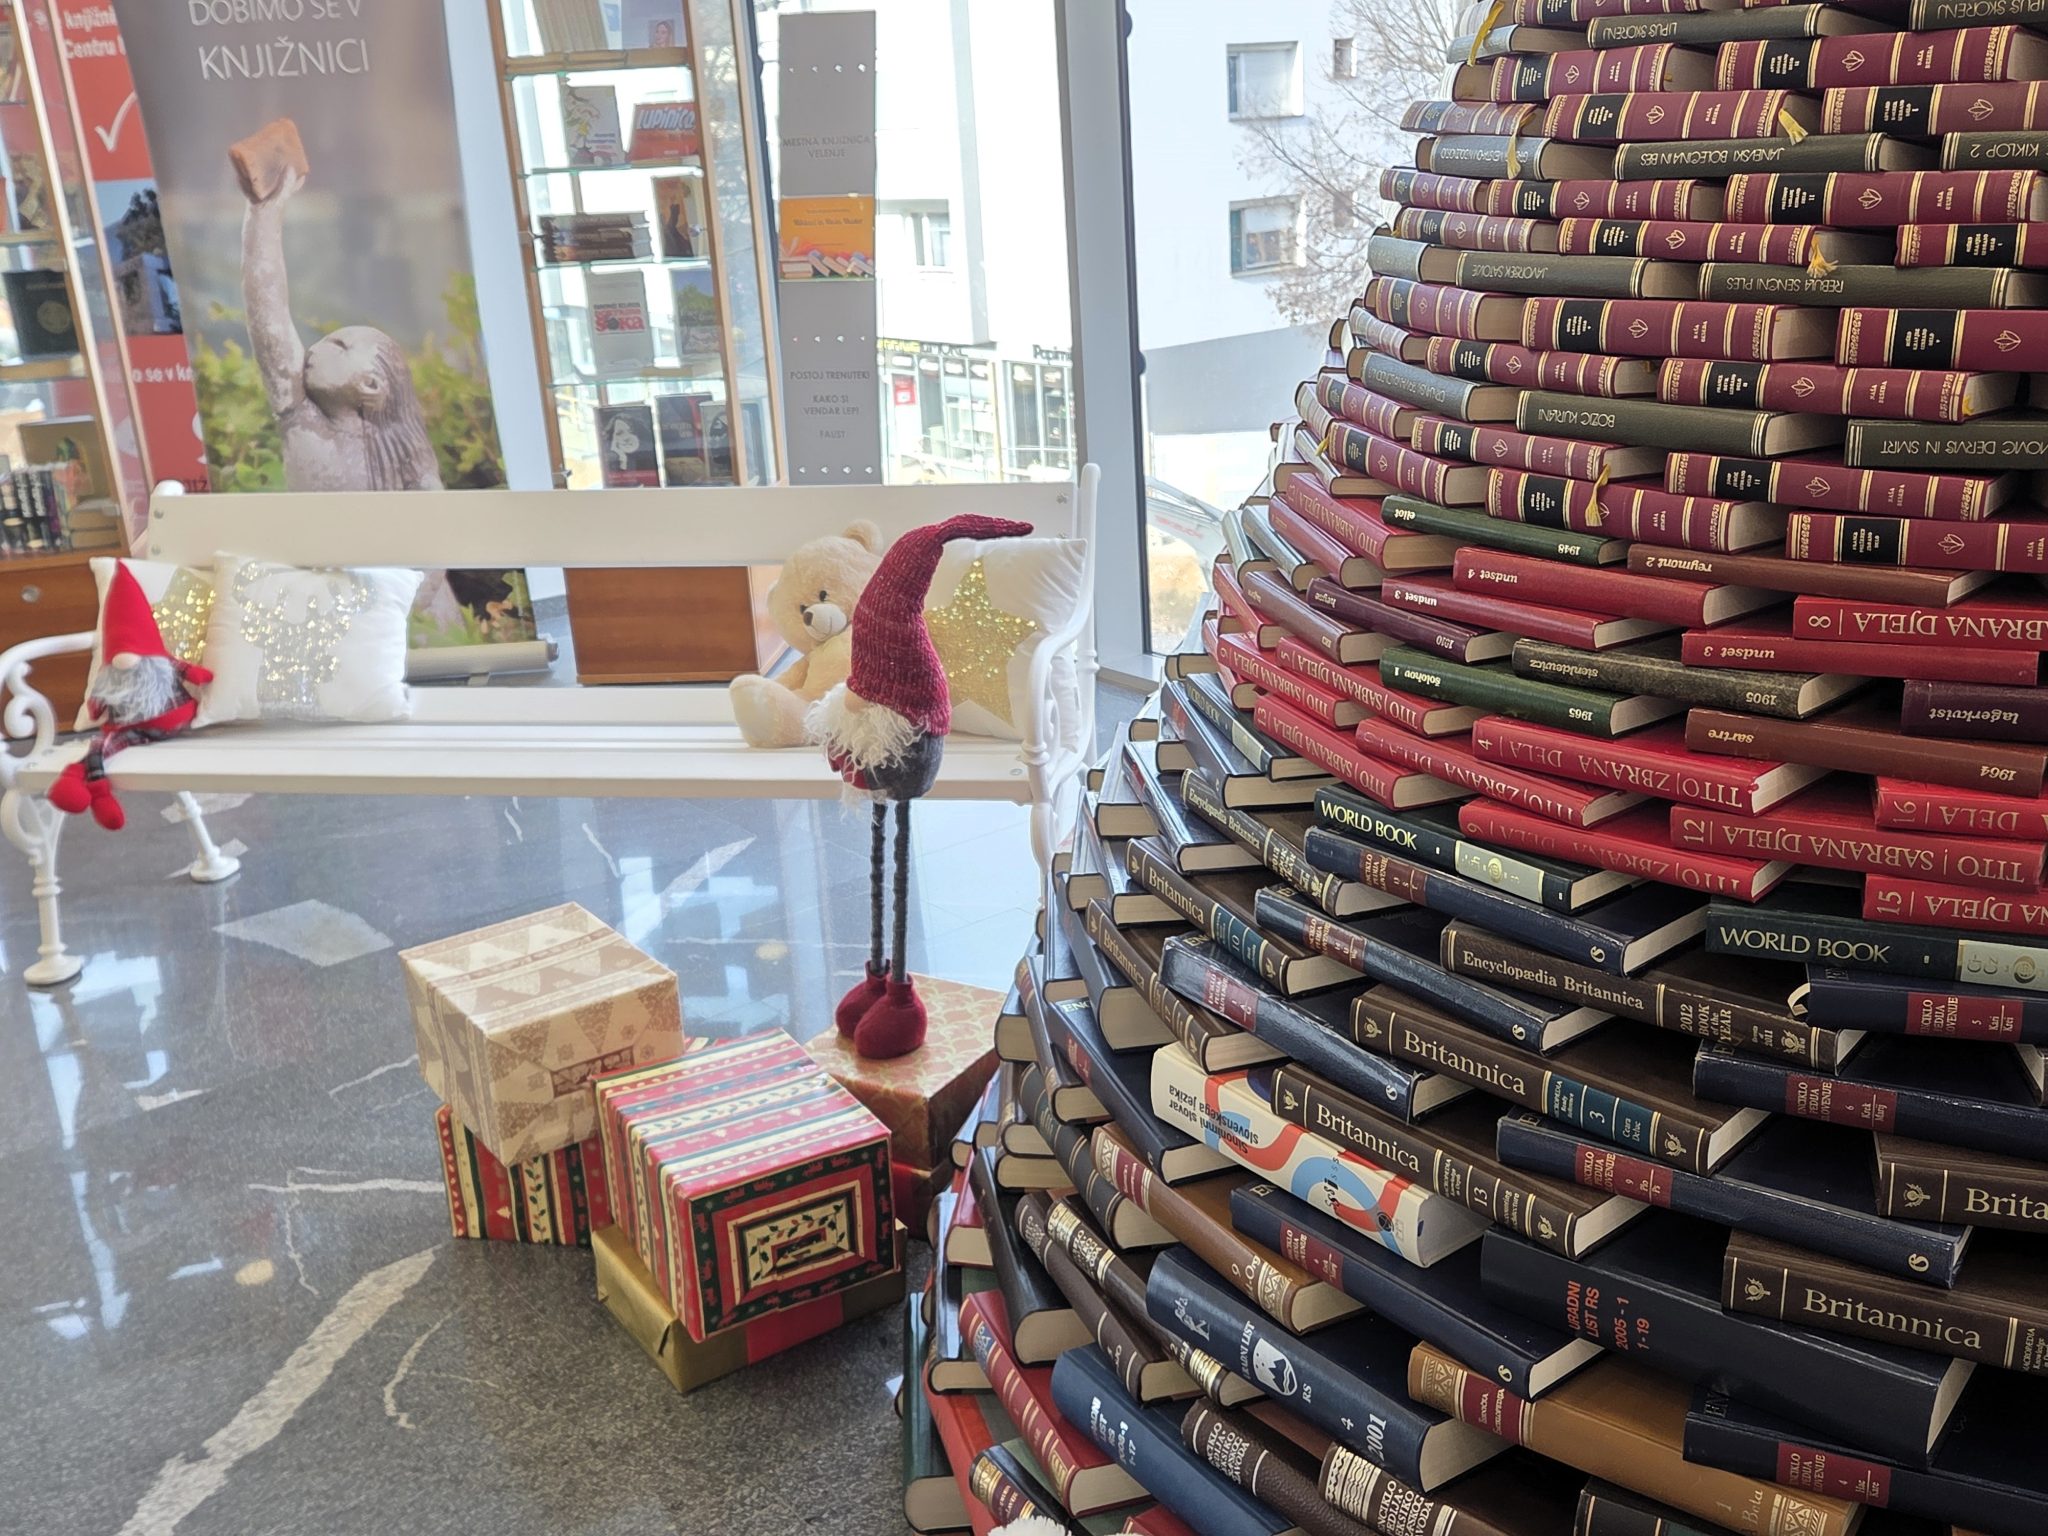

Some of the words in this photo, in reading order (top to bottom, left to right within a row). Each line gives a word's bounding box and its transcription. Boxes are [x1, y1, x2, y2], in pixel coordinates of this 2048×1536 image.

[189, 0, 302, 26] DOBIMO
[310, 0, 342, 21] SE
[347, 0, 363, 18] V
[199, 36, 370, 81] KNJIŽNICI
[808, 149, 847, 159] VELENJE
[1640, 153, 1659, 166] BES
[1969, 144, 1981, 158] 2
[1986, 143, 2040, 159] KIKLOP
[1726, 277, 1754, 290] PLES
[812, 394, 839, 404] KAKO
[1879, 440, 1920, 456] SMRT
[1925, 440, 1941, 455] IN
[1394, 508, 1416, 521] eliot
[1557, 543, 1581, 556] 1948
[1646, 556, 1654, 567] 2
[1479, 568, 1518, 584] undset
[1657, 556, 1713, 574] reymont
[1394, 589, 1401, 600] 3
[1404, 591, 1438, 608] undset
[1808, 614, 1832, 628] 8
[1852, 610, 1939, 636] DJELA
[1704, 645, 1713, 657] 3
[1720, 646, 1776, 660] undset
[1297, 654, 1330, 685] DJELA
[1261, 670, 1301, 701] SABRANA
[1331, 675, 1383, 710] SABRANA
[1306, 693, 1329, 719] TITO
[1745, 691, 1778, 707] 1905
[1389, 701, 1417, 729] TITO
[1568, 706, 1594, 721] 1965
[1929, 707, 2020, 725] lagerkvist
[1273, 716, 1304, 749] DJELA
[1477, 738, 1493, 750] 4
[1707, 728, 1755, 744] sartre
[1305, 742, 1353, 778] SABRANA
[1509, 739, 1562, 768] DELA
[1360, 771, 1387, 799] TITO
[1577, 754, 1671, 791] ZBRANA
[1979, 765, 2017, 782] 1964
[1682, 777, 1743, 808] TITO
[1320, 798, 1373, 833] WORLD
[1375, 816, 1419, 851] BOOK
[1683, 818, 1706, 844] 12
[1939, 806, 2020, 832] DELA
[1722, 824, 1801, 855] DJELA
[1809, 836, 1935, 871] SABRANA
[1957, 855, 2025, 883] TITO
[1150, 866, 1205, 925] Britannica
[1876, 890, 1902, 915] 15
[1924, 895, 2013, 923] DJELA
[1719, 925, 1811, 955] WORLD
[1817, 937, 1891, 964] BOOK
[1104, 931, 1145, 991] Britannica
[1463, 950, 1558, 988] Encyclopædia
[1563, 975, 1645, 1010] Britannica
[1680, 1003, 1694, 1033] 2012
[1698, 1003, 1710, 1037] BOOK
[1720, 1008, 1732, 1043] YEAR
[1404, 1030, 1526, 1096] Britannica
[1168, 1084, 1198, 1107] jezika
[1168, 1100, 1198, 1123] slovar
[1198, 1100, 1260, 1145] slovenskega
[1589, 1110, 1605, 1124] 3
[1315, 1103, 1421, 1173] Britannica
[1474, 1186, 1488, 1207] 13
[1567, 1280, 1581, 1331] URADNI
[1587, 1286, 1600, 1308] RS
[1585, 1308, 1599, 1337] LIST
[1802, 1287, 1982, 1350] Britannica
[1241, 1320, 1256, 1346] LIST
[1616, 1319, 1628, 1350] 2005
[1302, 1383, 1312, 1404] RS
[1340, 1416, 1354, 1431] 4
